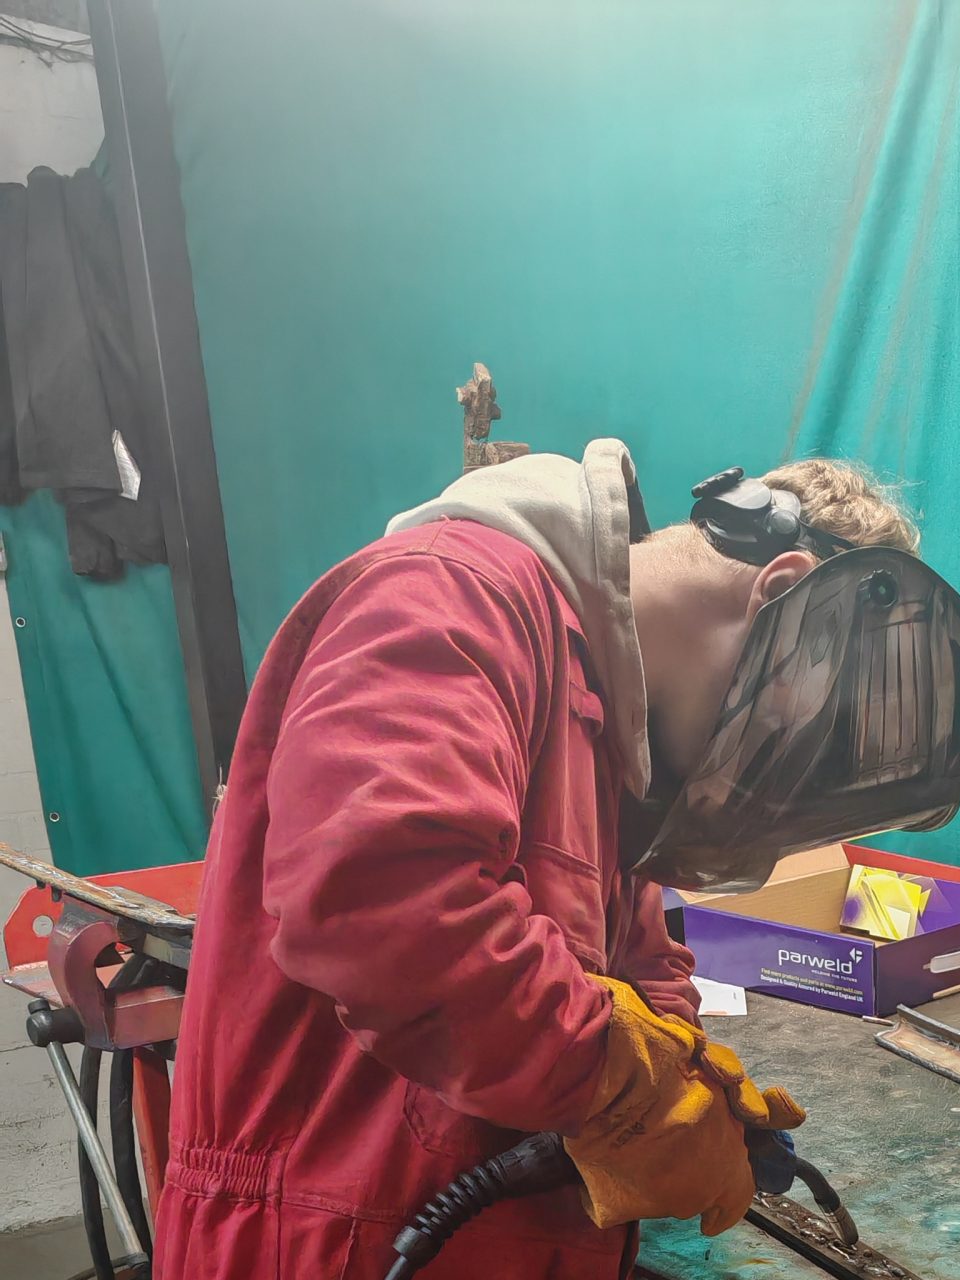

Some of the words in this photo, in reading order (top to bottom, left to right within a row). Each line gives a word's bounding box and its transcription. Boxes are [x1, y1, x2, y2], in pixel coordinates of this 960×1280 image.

[778, 949, 853, 975] parweld
[761, 974, 779, 984] Designed
[784, 980, 798, 988] Quality
[798, 983, 815, 991] Assured
[821, 988, 838, 996] Parweld
[839, 992, 856, 1001] England
